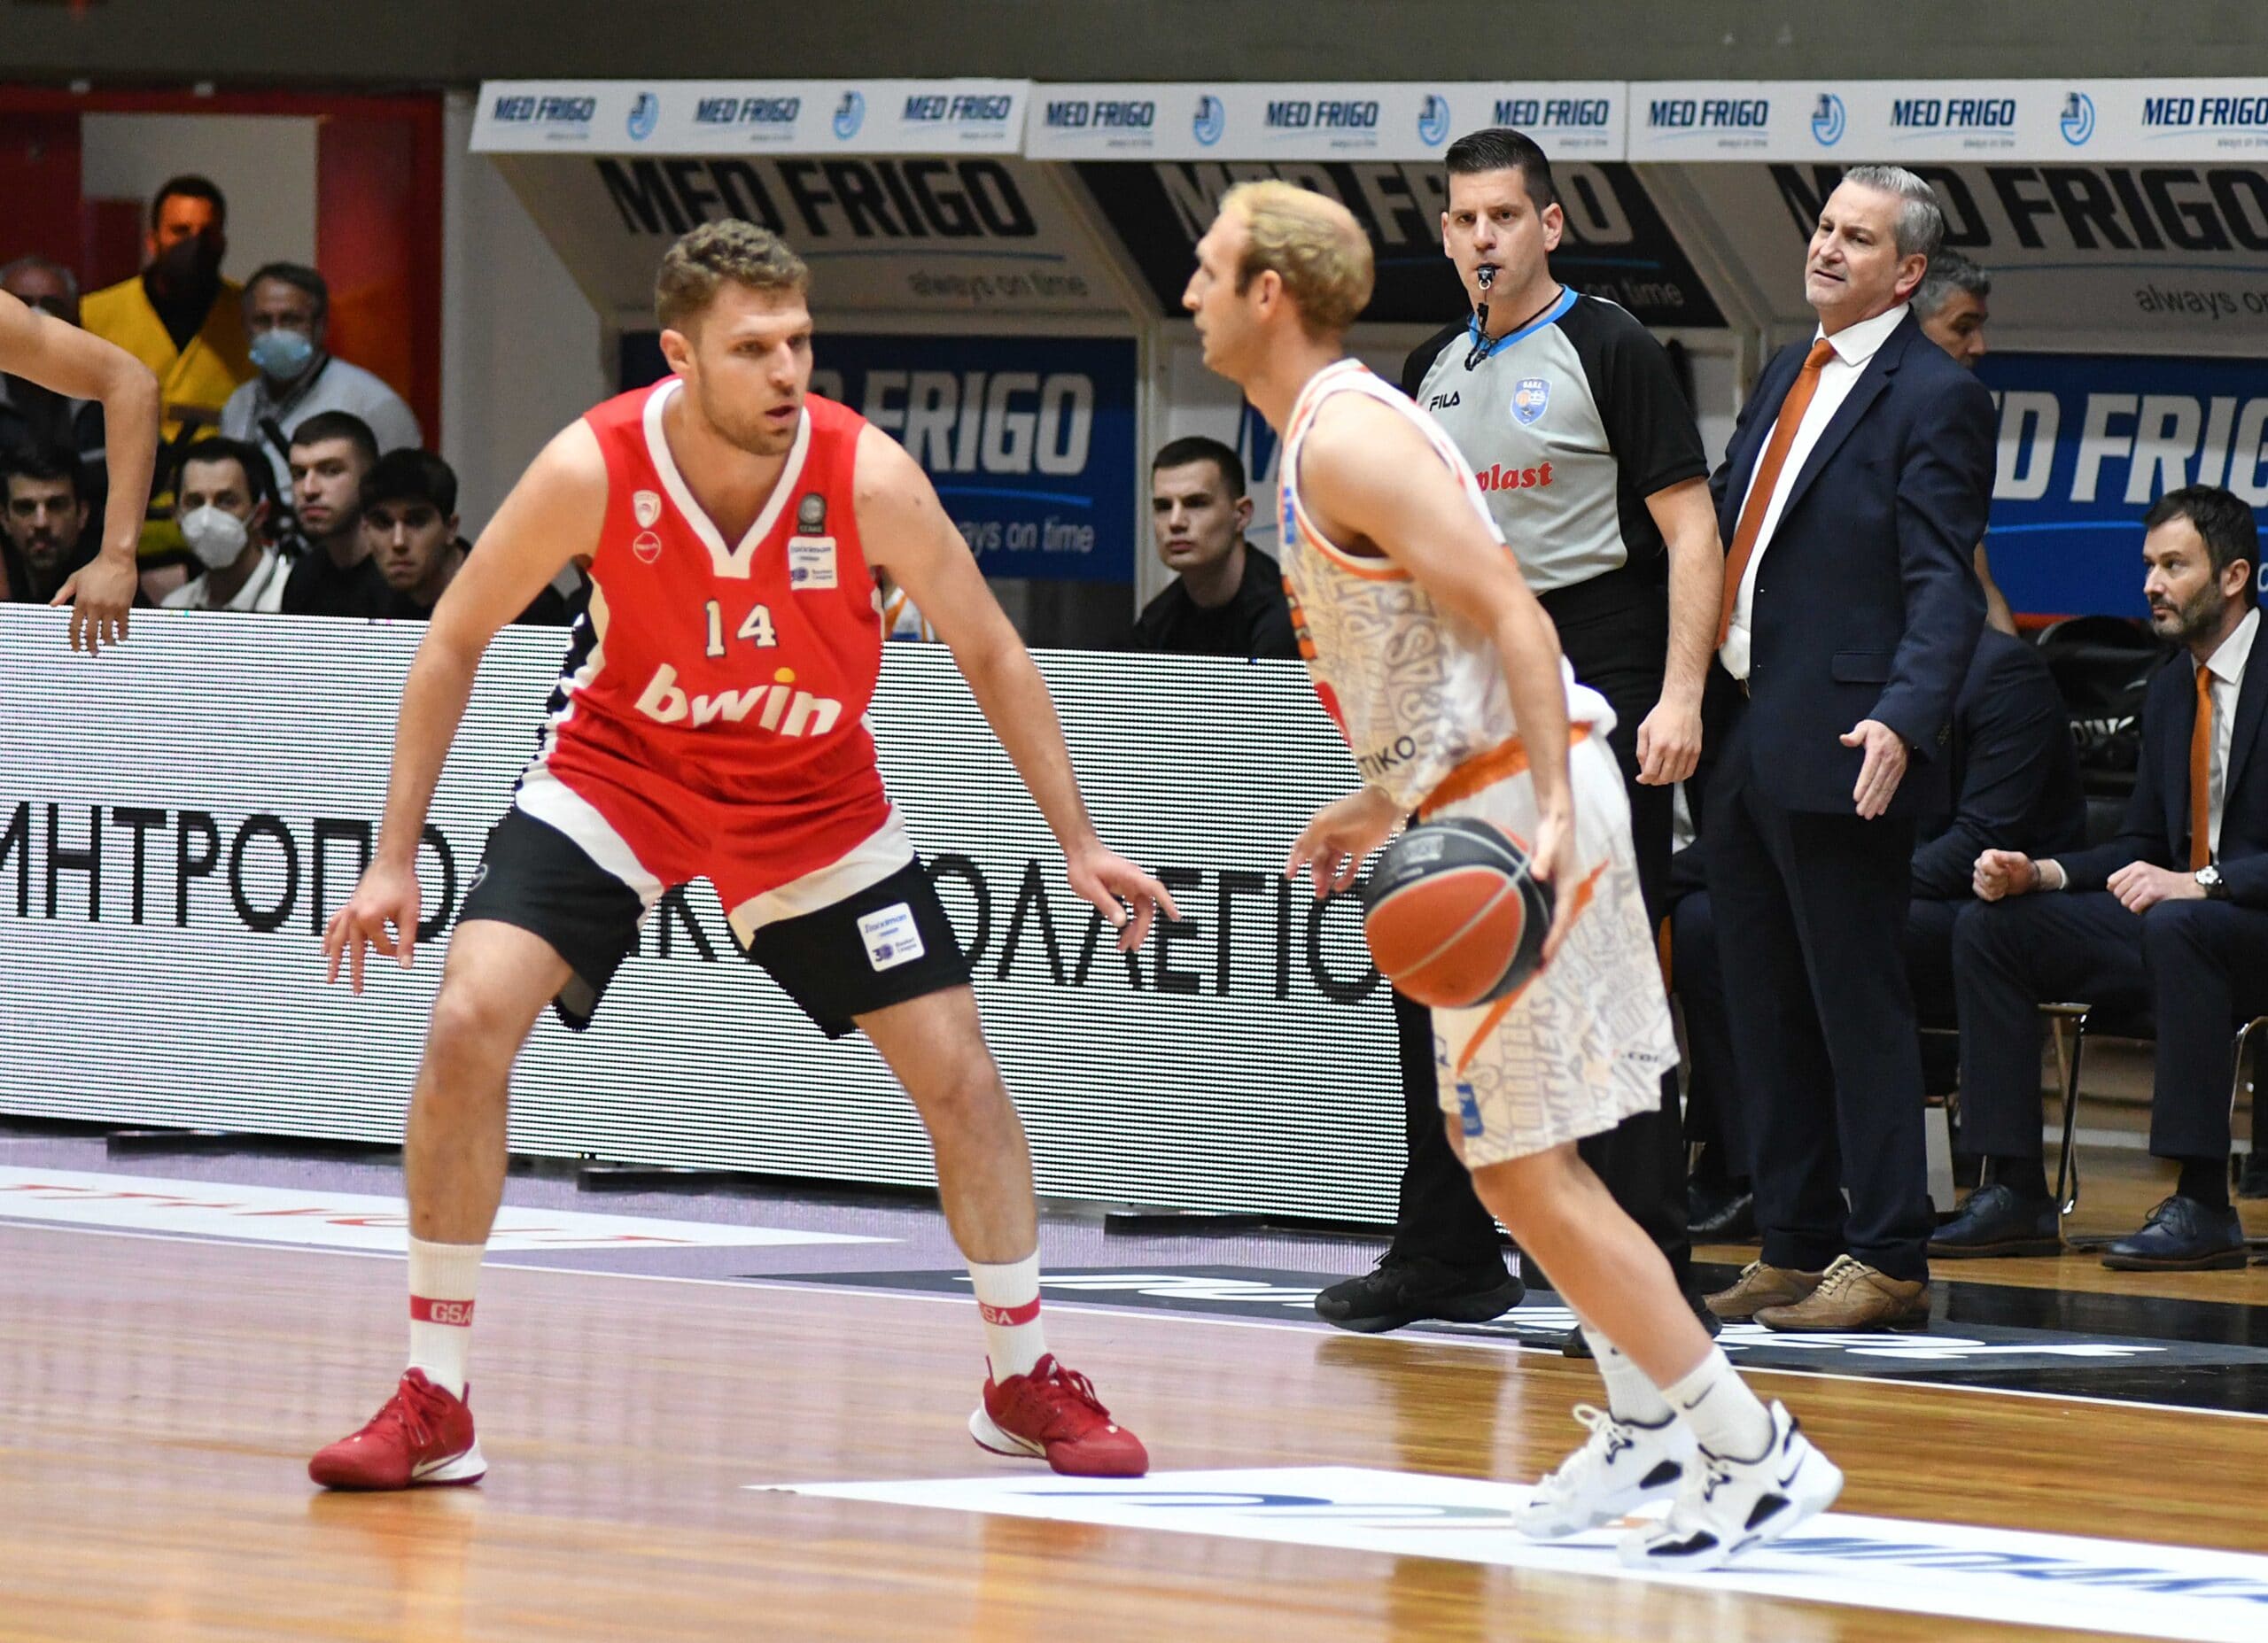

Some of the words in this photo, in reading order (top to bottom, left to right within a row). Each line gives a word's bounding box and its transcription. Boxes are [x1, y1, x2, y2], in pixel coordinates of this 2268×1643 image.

[902, 95, 948, 120] MED
[948, 95, 1013, 121] FRIGO
[1045, 100, 1090, 127] MED
[1091, 101, 1155, 127] FRIGO
[1265, 100, 1312, 127] MED
[1314, 100, 1379, 127] FRIGO
[1494, 99, 1540, 127] MED
[1543, 99, 1611, 127] FRIGO
[1650, 99, 1697, 127] MED
[1700, 99, 1769, 127] FRIGO
[1891, 98, 1941, 127] MED
[1945, 98, 2016, 128] FRIGO
[2141, 97, 2197, 126] MED
[2198, 97, 2268, 126] FRIGO
[773, 159, 1037, 238] FRIGO
[2133, 283, 2237, 320] always
[1428, 390, 1461, 412] FILA
[863, 370, 1094, 476] FRIGO
[1006, 522, 1038, 552] on
[1043, 514, 1095, 554] time
[705, 599, 779, 658] 14
[633, 662, 843, 737] bwin
[430, 1301, 472, 1324] GSA
